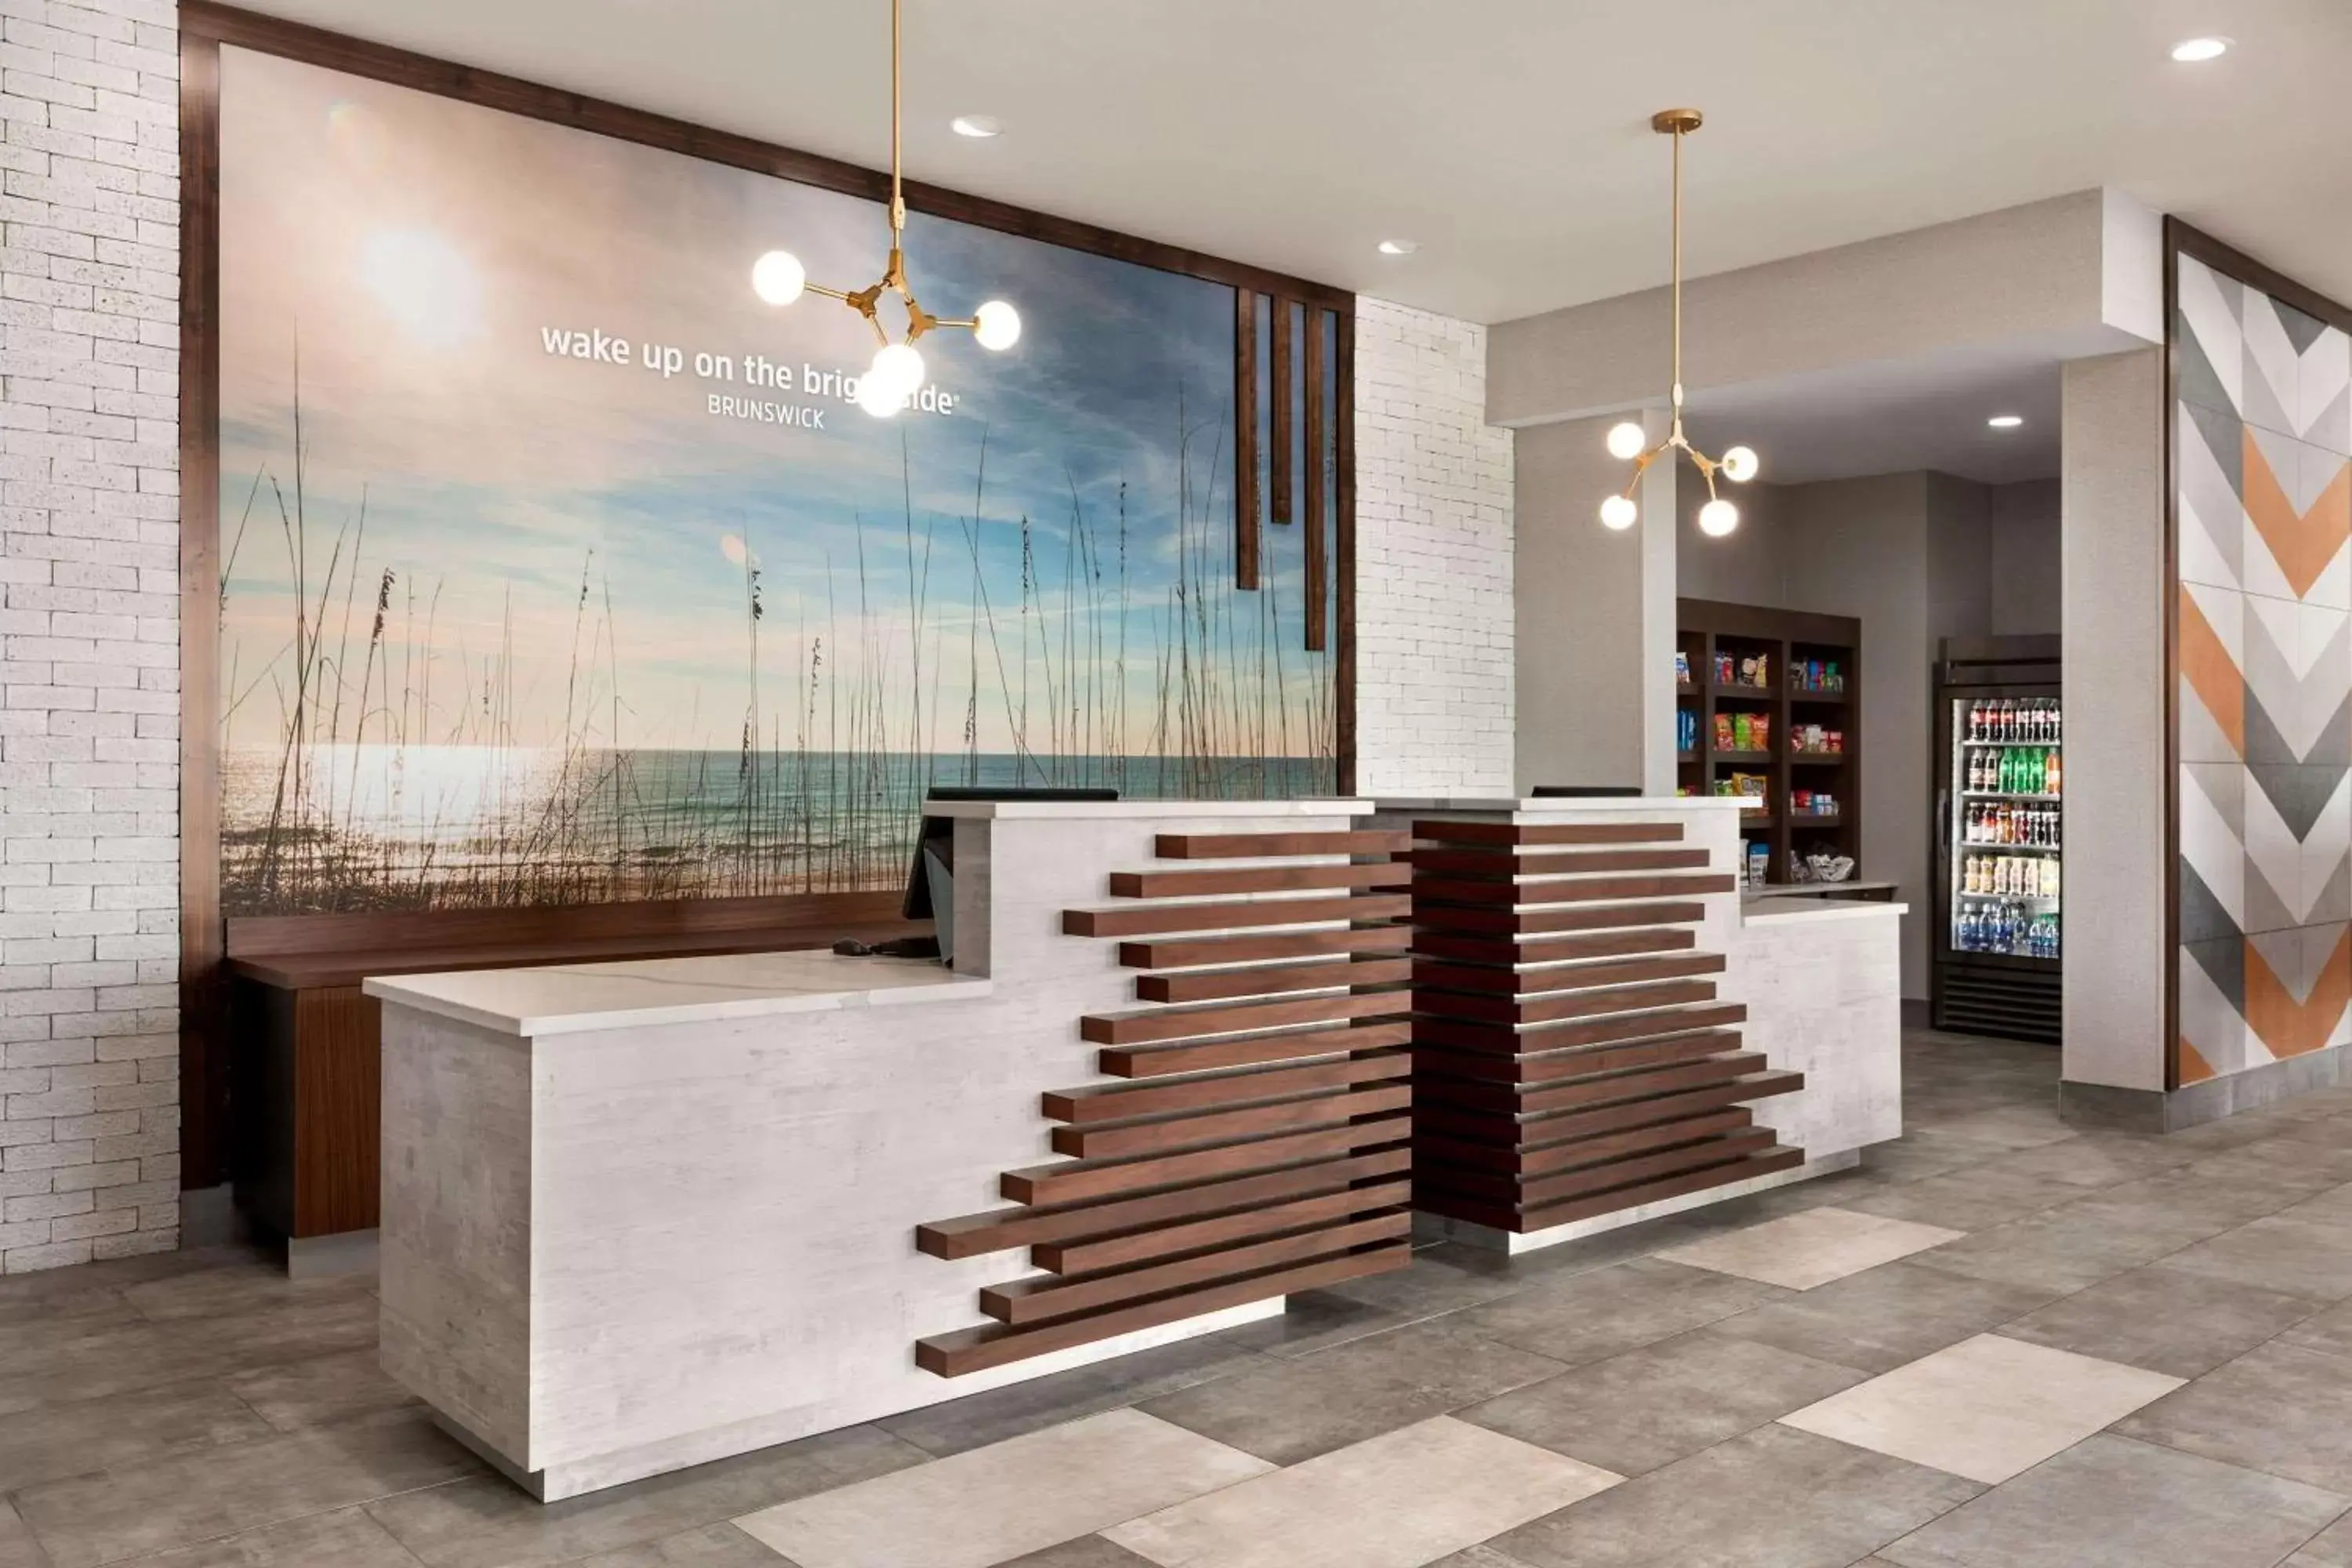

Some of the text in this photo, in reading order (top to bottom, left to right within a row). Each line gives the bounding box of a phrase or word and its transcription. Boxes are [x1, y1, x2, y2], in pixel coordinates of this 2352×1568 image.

[541, 326, 630, 365] wake
[642, 345, 683, 378] up
[695, 352, 734, 381] on
[744, 355, 793, 390] the
[803, 363, 886, 405] brig
[708, 394, 825, 429] BRUNSWICK
